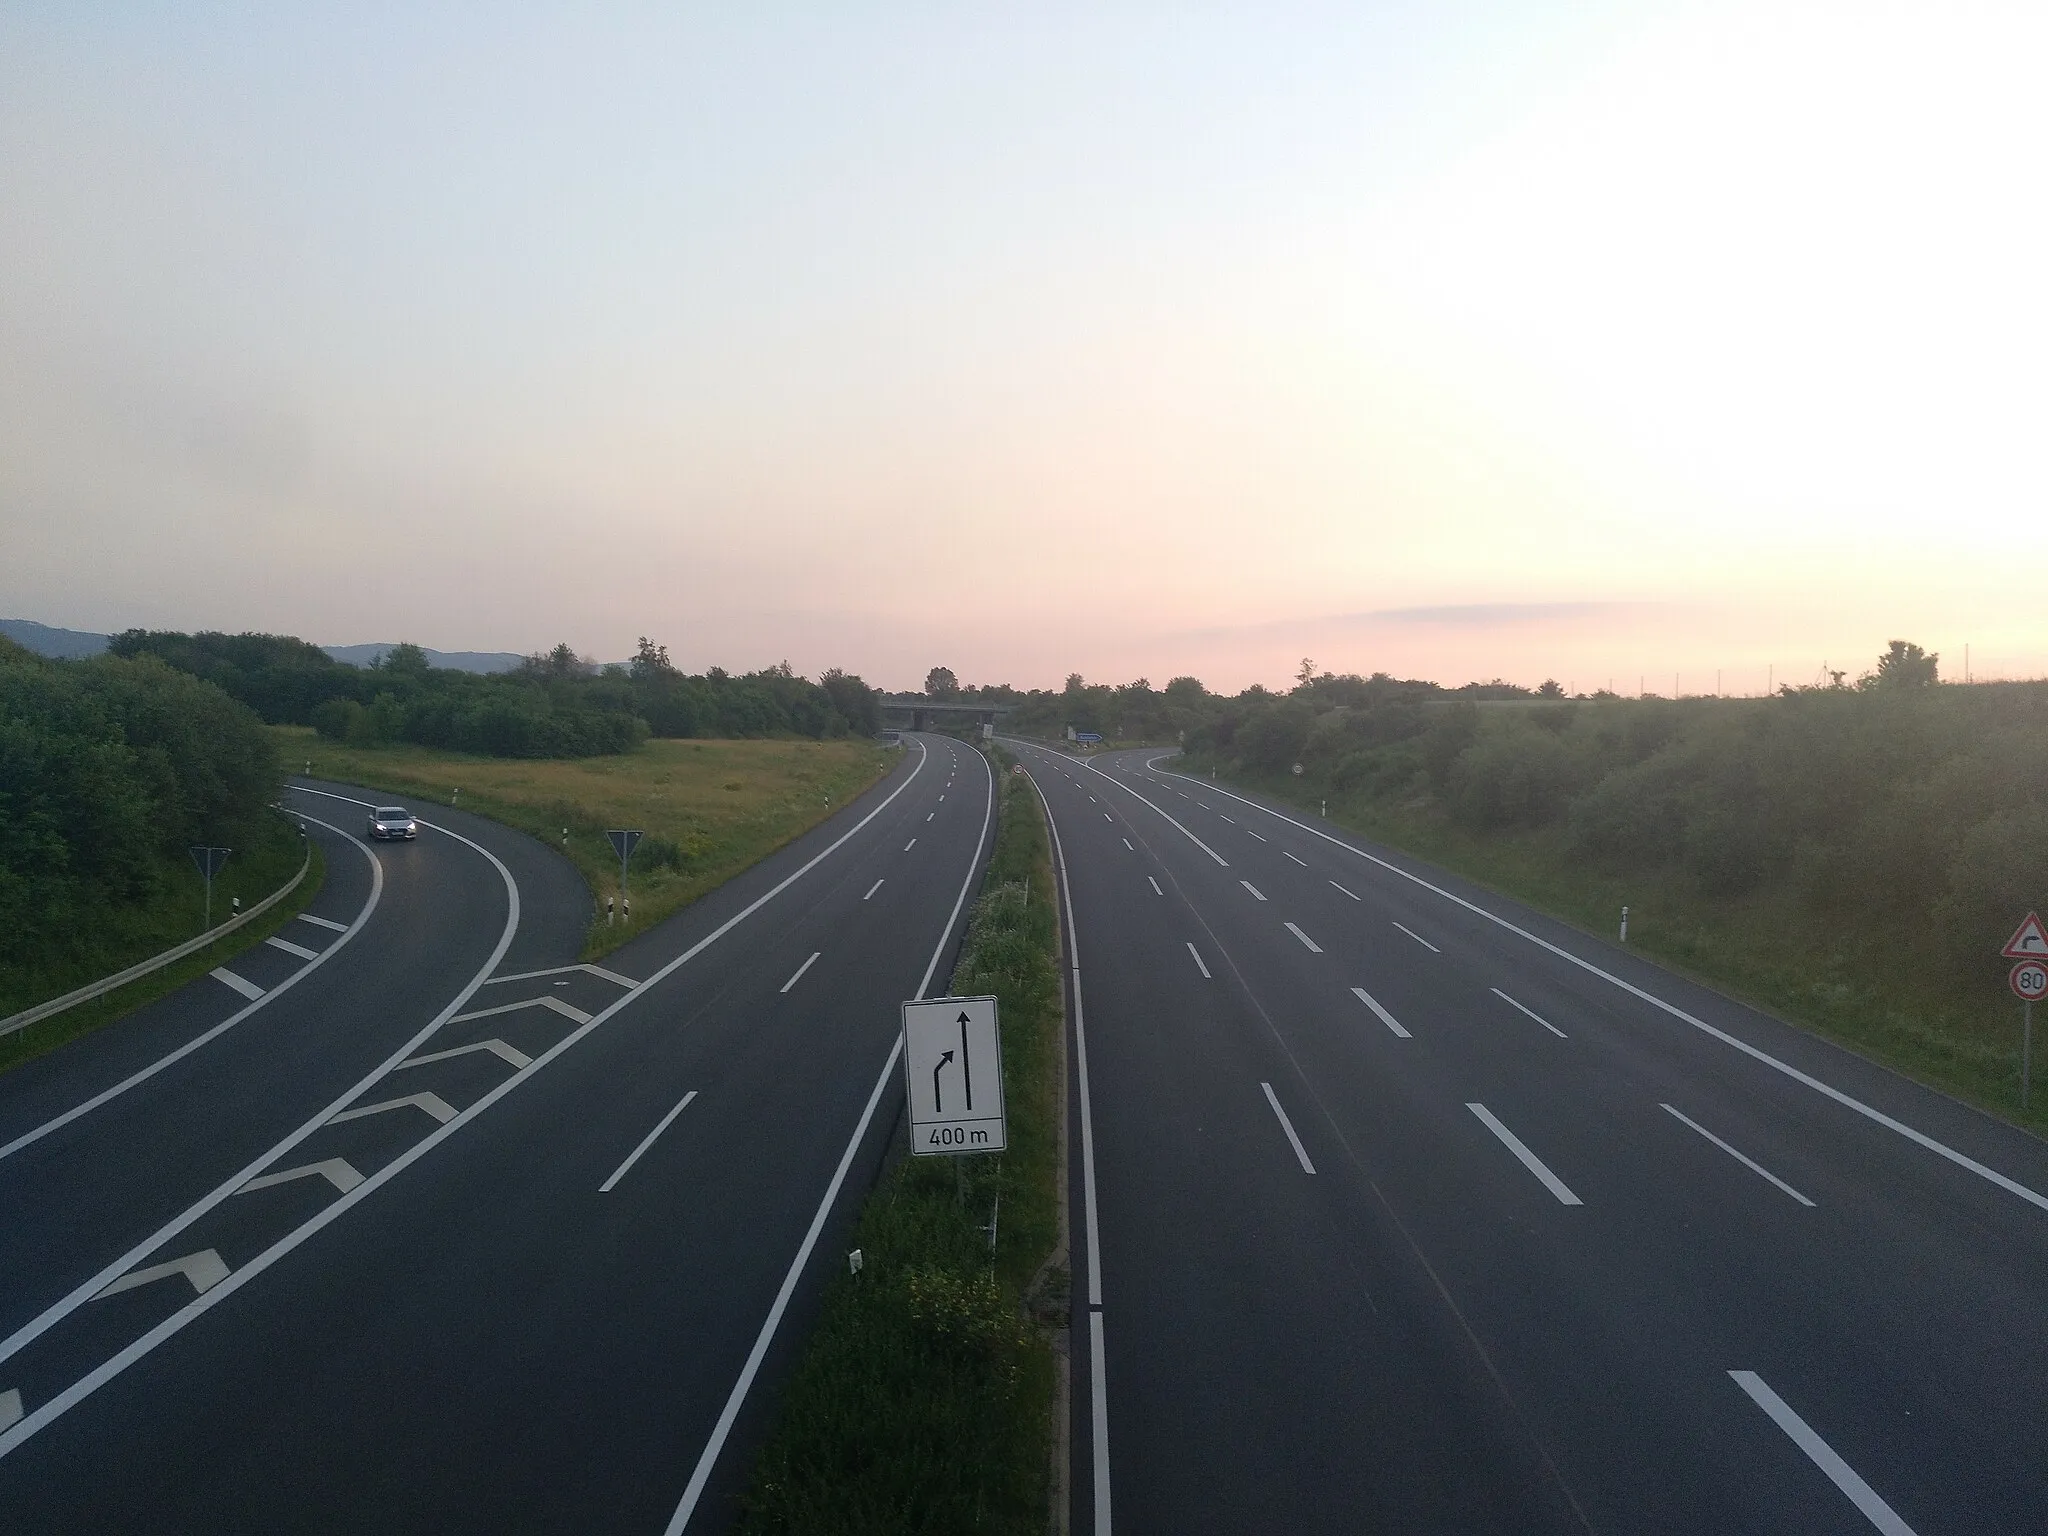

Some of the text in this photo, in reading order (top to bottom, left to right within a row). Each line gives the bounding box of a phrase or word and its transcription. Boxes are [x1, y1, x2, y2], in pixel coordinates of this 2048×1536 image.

[2021, 971, 2043, 989] 80
[929, 1127, 988, 1146] 400 m
